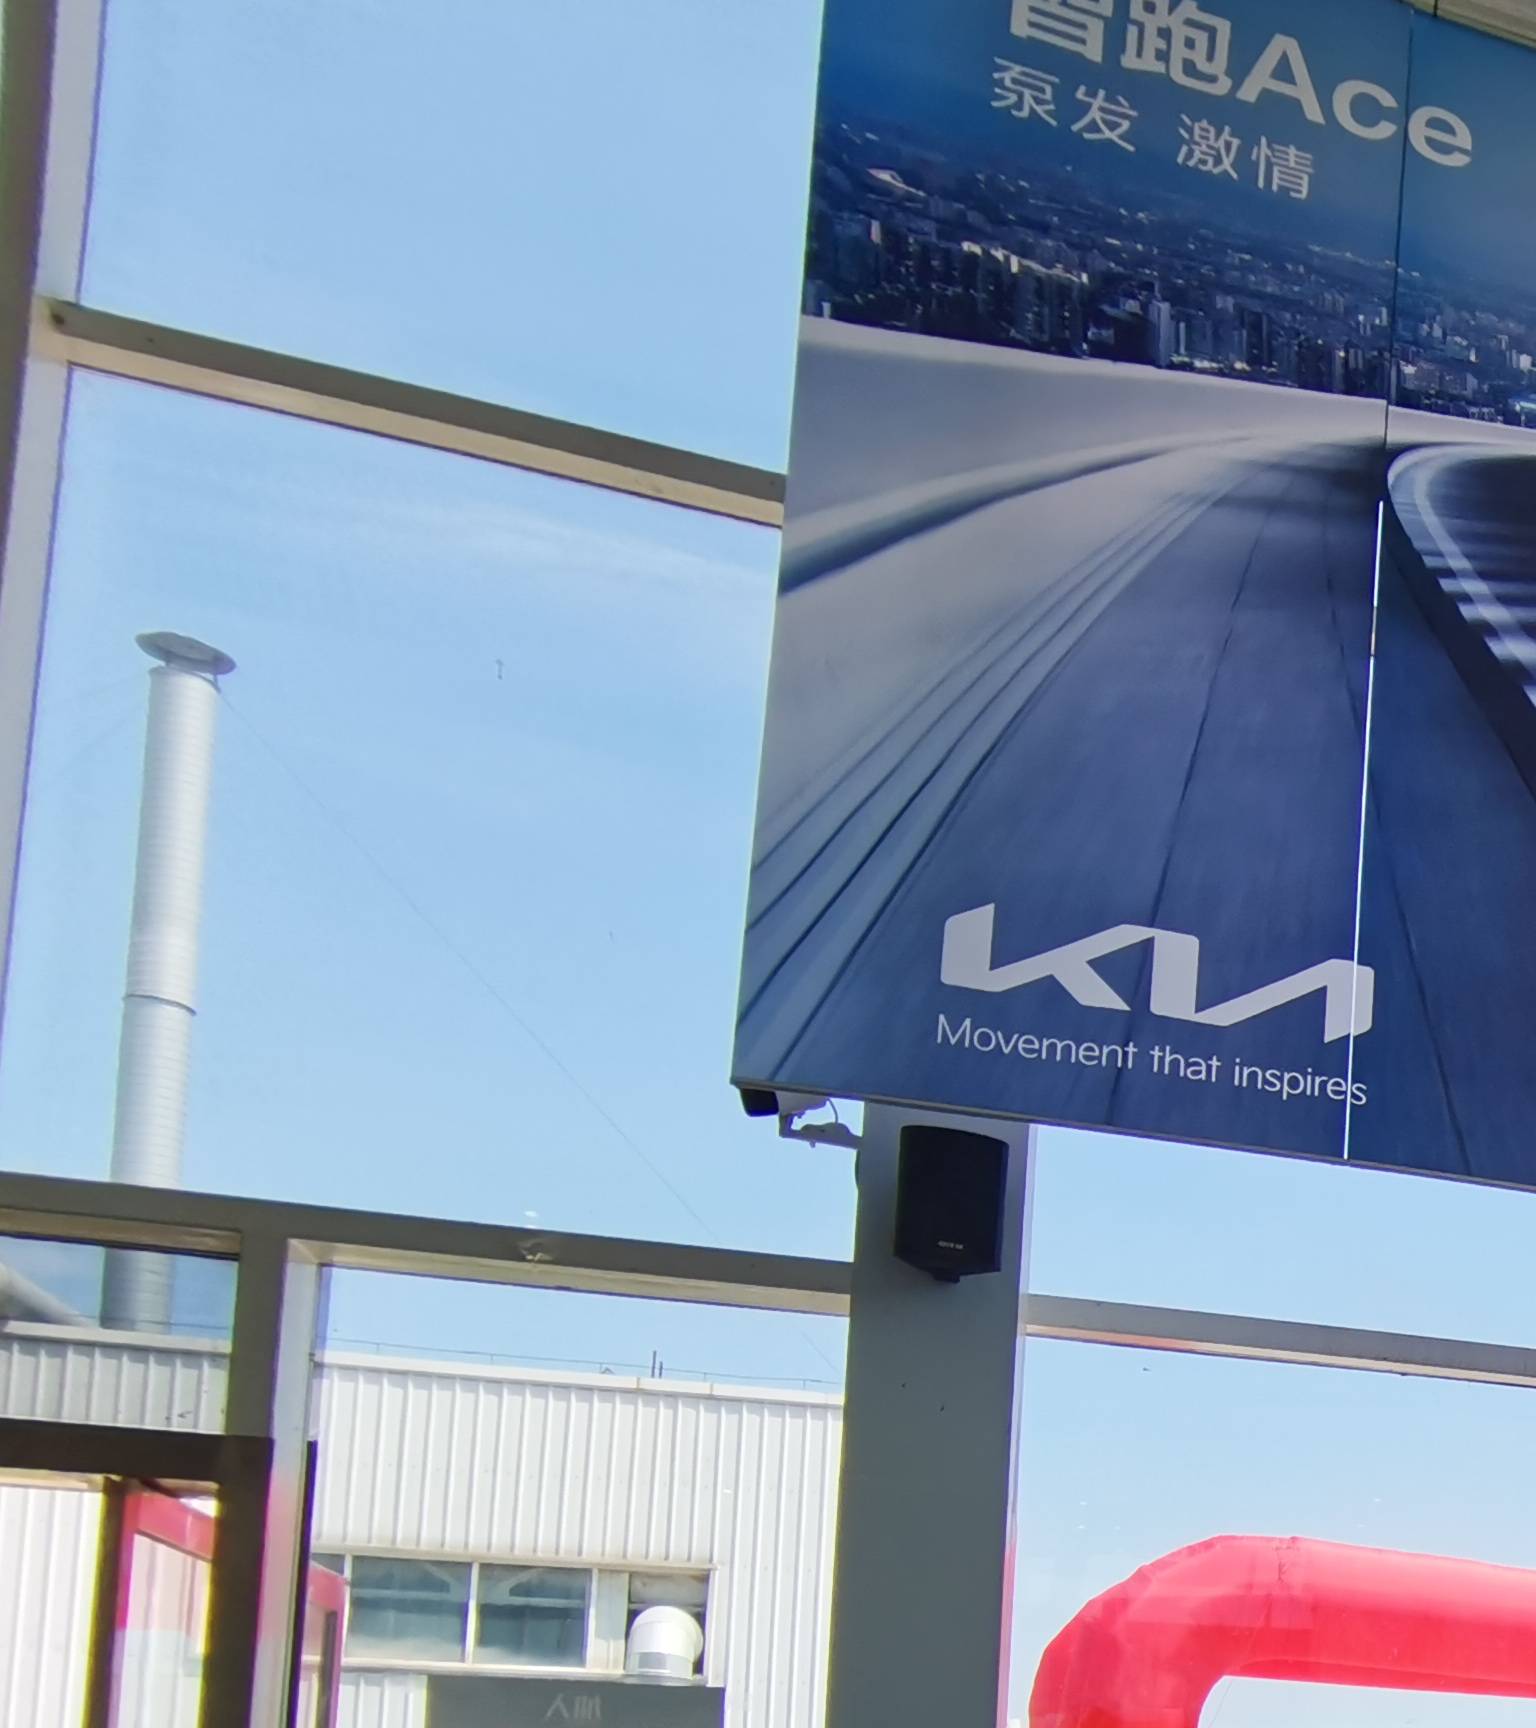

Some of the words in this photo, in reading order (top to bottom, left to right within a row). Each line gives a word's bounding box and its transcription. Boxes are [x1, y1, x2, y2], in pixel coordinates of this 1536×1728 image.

[1176, 112, 1316, 199] 激情
[940, 902, 1375, 1044] KIA
[936, 1012, 1138, 1070] Movement
[1148, 1044, 1222, 1084] that
[1233, 1056, 1368, 1106] inspires
